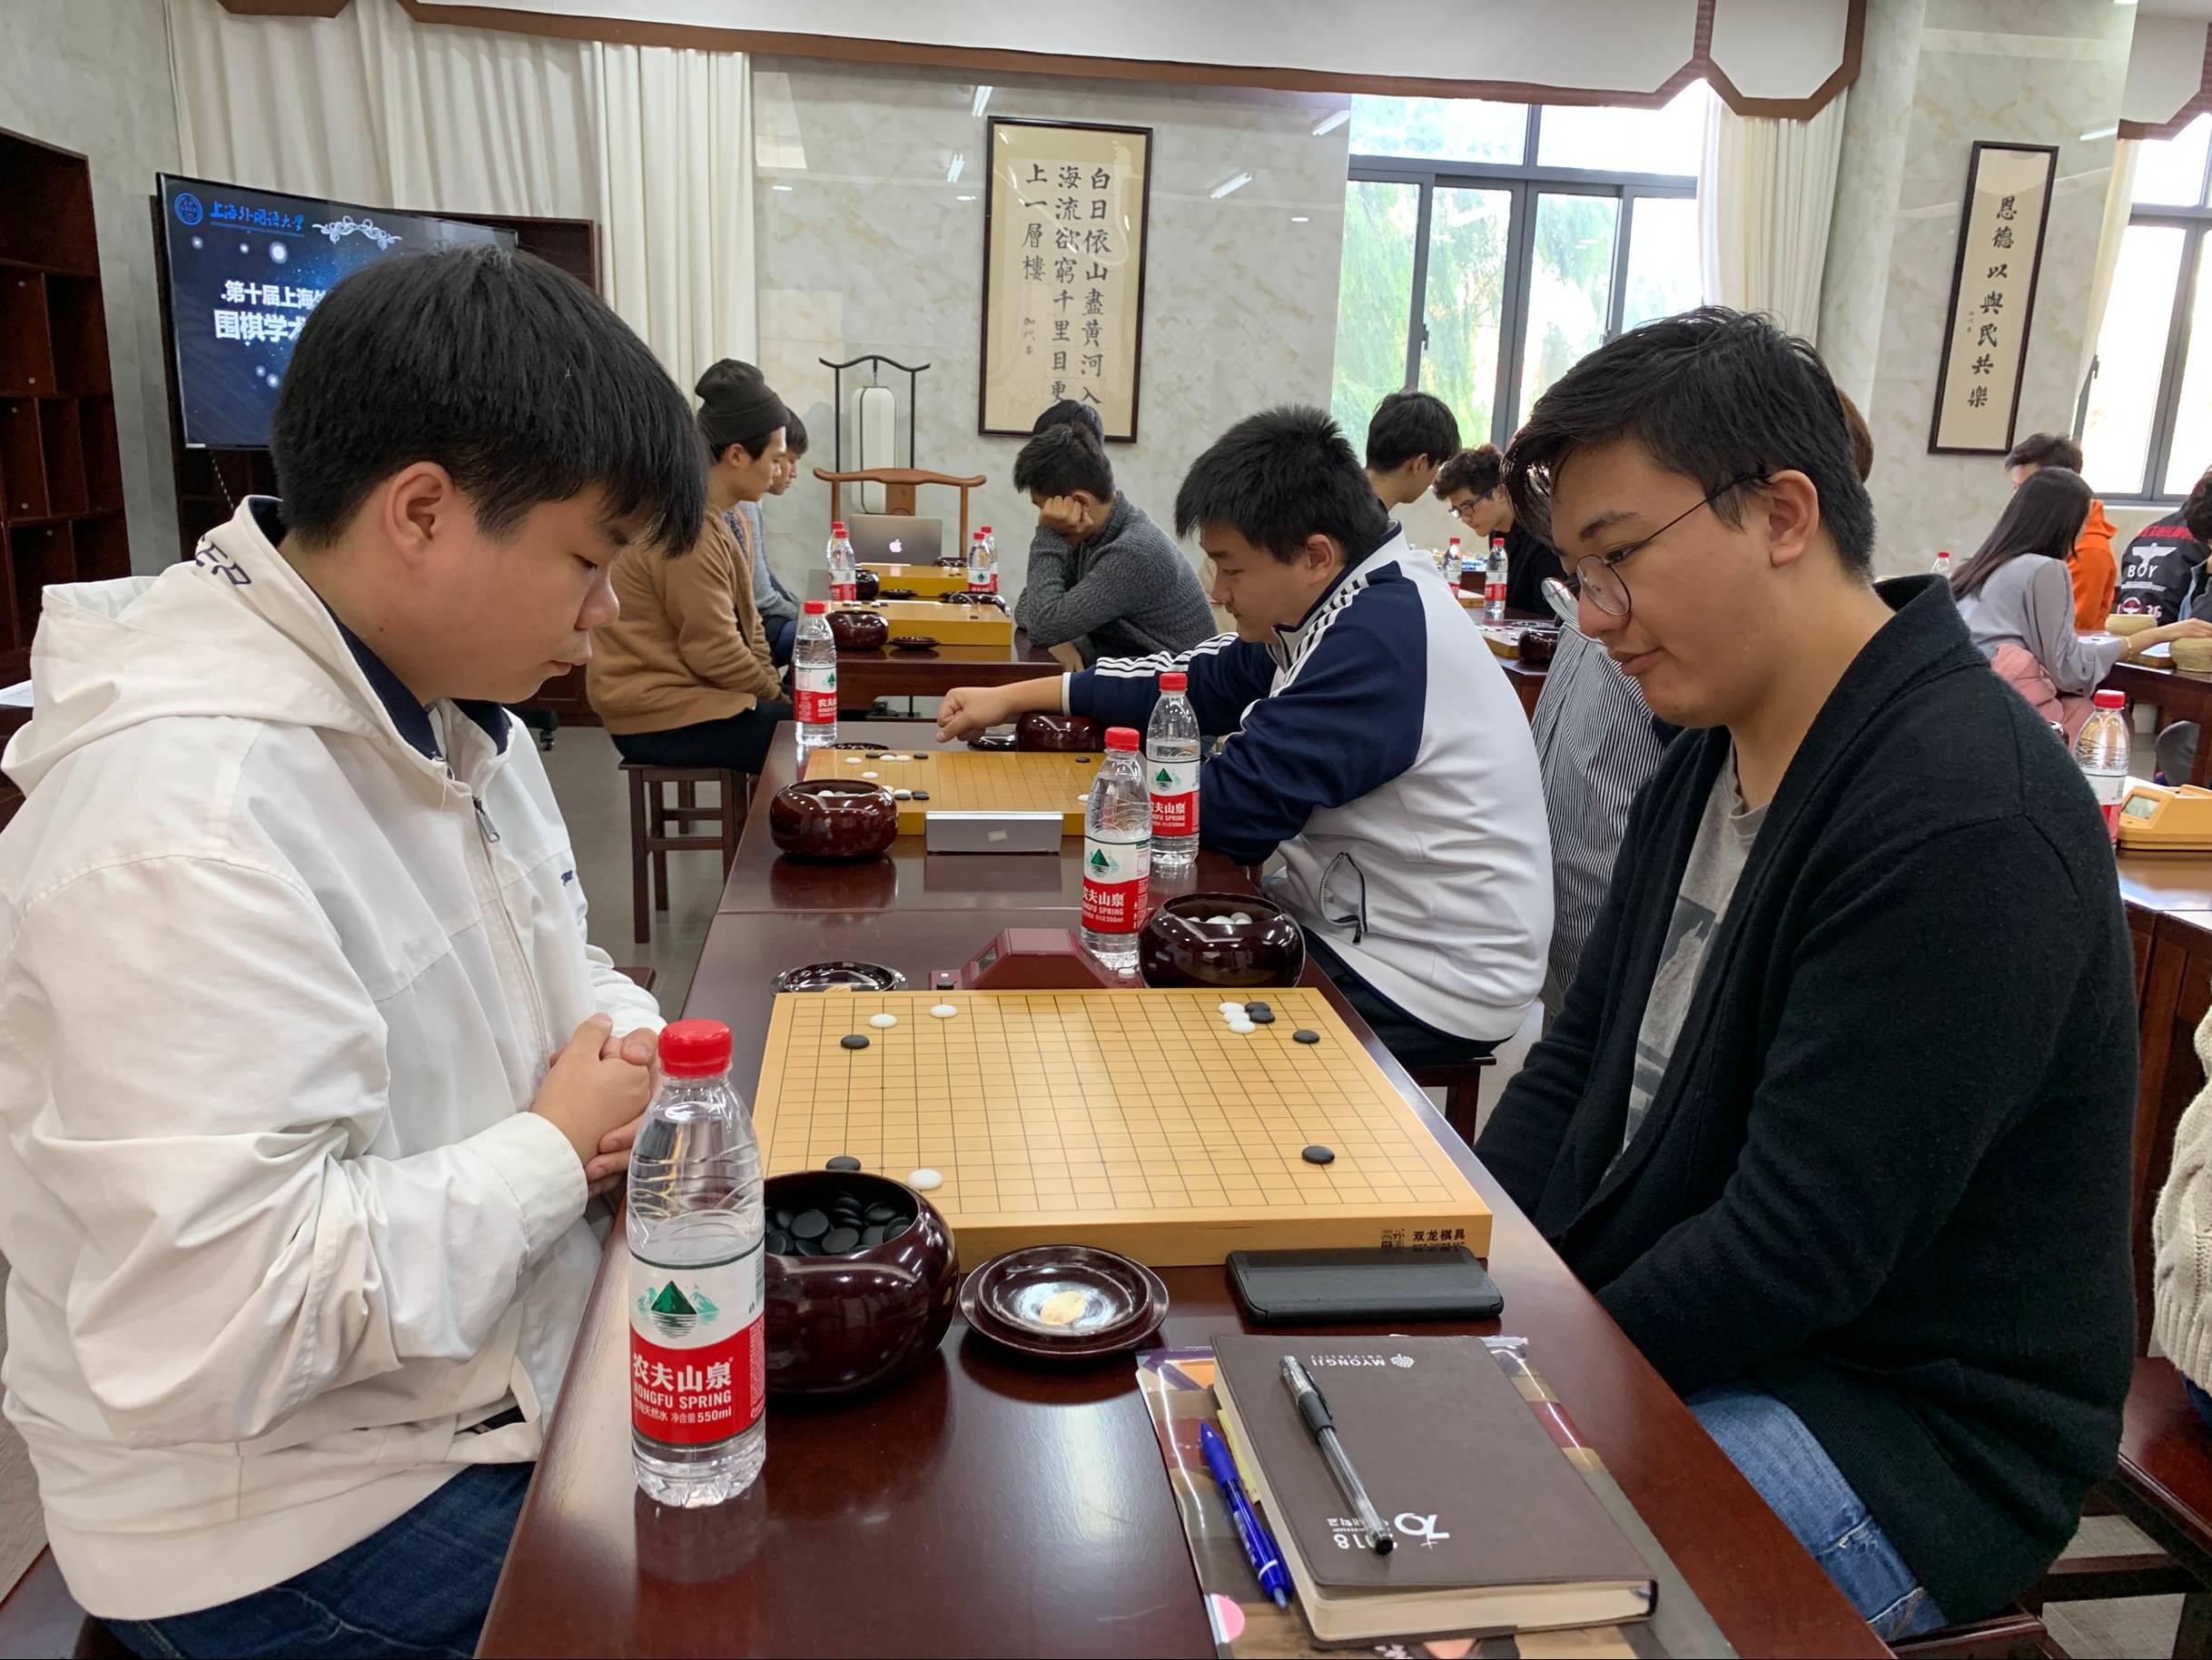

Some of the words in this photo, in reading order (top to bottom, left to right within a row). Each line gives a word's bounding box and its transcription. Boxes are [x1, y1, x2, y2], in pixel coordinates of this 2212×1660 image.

[1022, 163, 1048, 282] 上一層樓
[2127, 564, 2159, 578] BOY
[1099, 906, 1124, 916] SPRING
[1413, 1228, 1466, 1242] 双龙棋具
[1311, 1359, 1386, 1367] MYONGJI
[633, 1352, 732, 1392] 农夫山泉
[679, 1389, 732, 1409] SPRING
